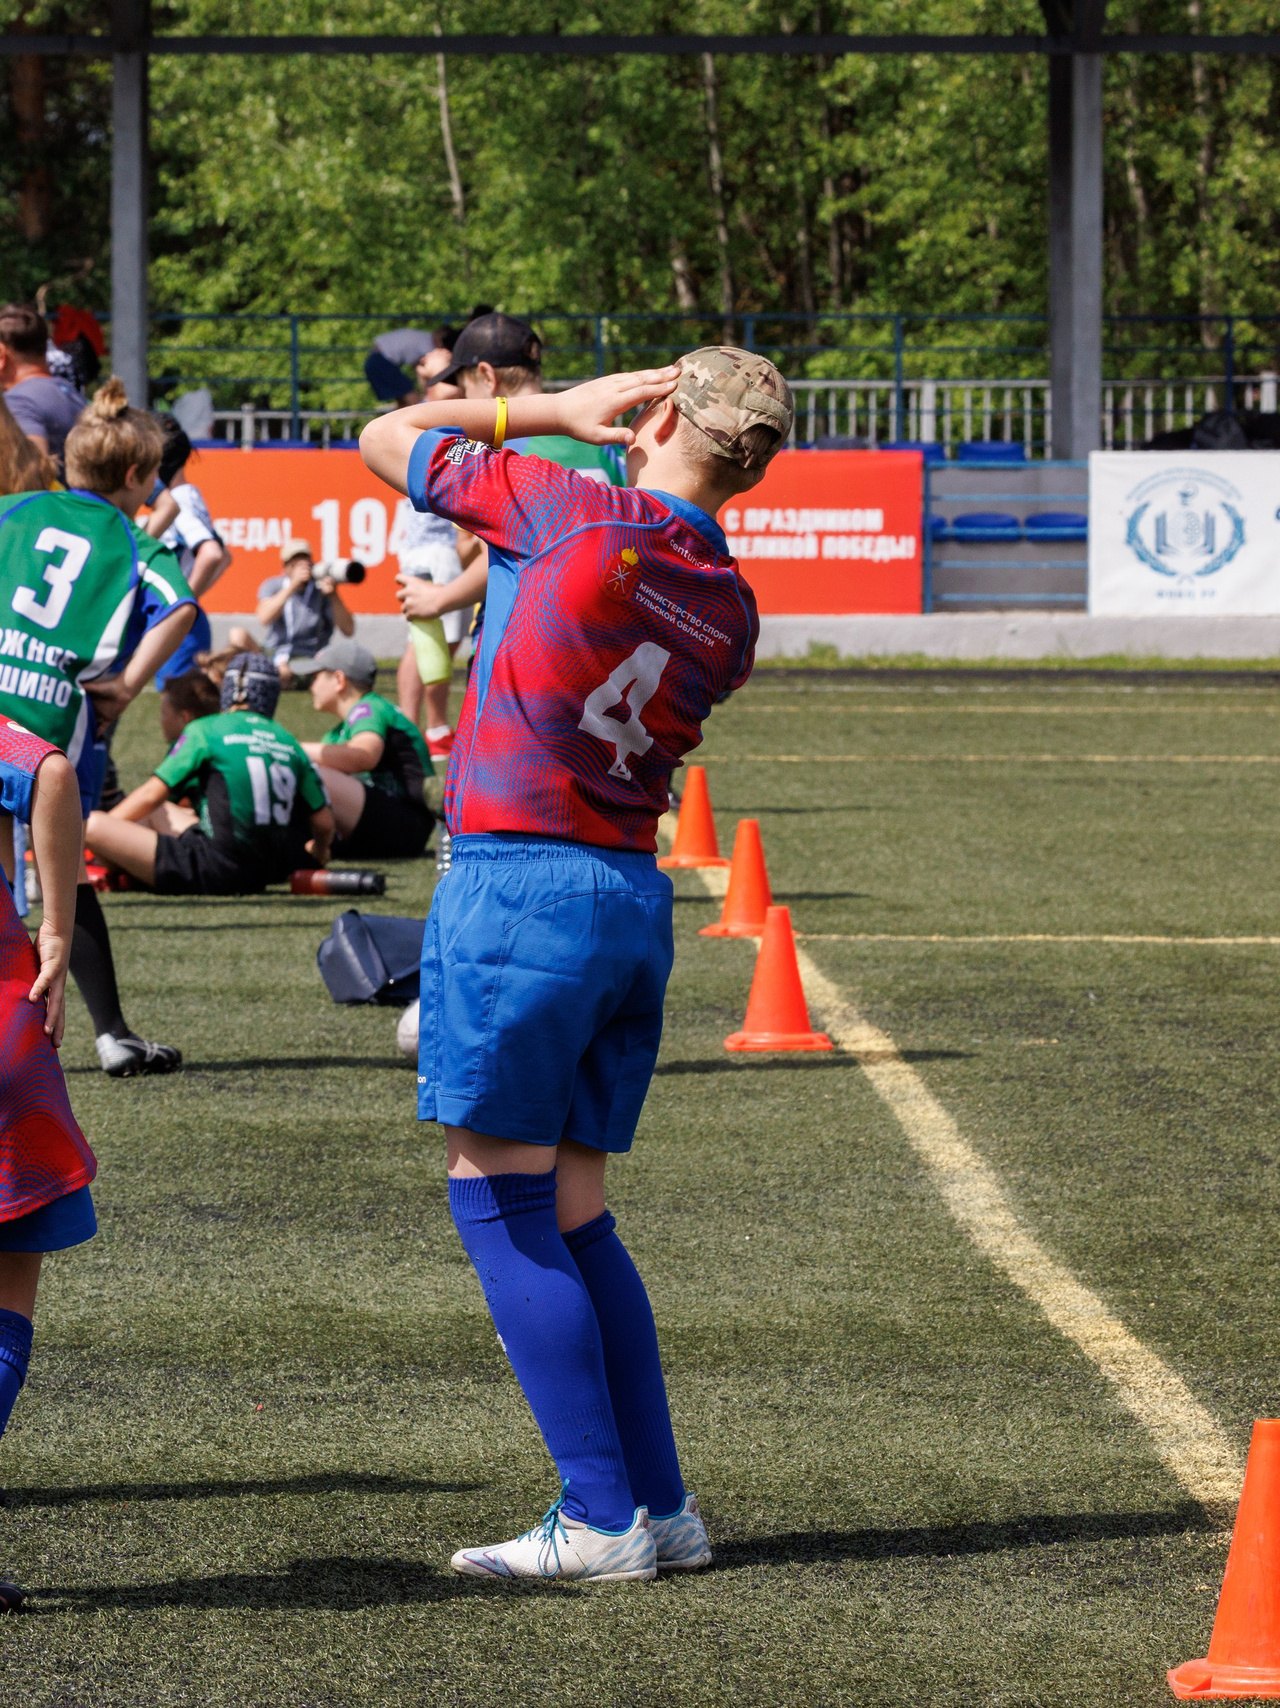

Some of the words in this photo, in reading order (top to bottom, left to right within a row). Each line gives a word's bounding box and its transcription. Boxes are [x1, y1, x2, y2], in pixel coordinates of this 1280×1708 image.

[725, 508, 740, 532] С
[743, 508, 884, 534] ПРАЗДНИКОМ
[821, 535, 916, 563] ПОБЕДЫ!
[11, 526, 91, 629] 3
[635, 591, 676, 624] ТУЛЬСКОЙ
[676, 619, 715, 648] ОБЛАСТИ
[638, 582, 703, 627] МИНИСТЕРСТВО
[702, 623, 732, 646] СПОРТА
[577, 641, 671, 781] 4
[245, 756, 296, 825] 19
